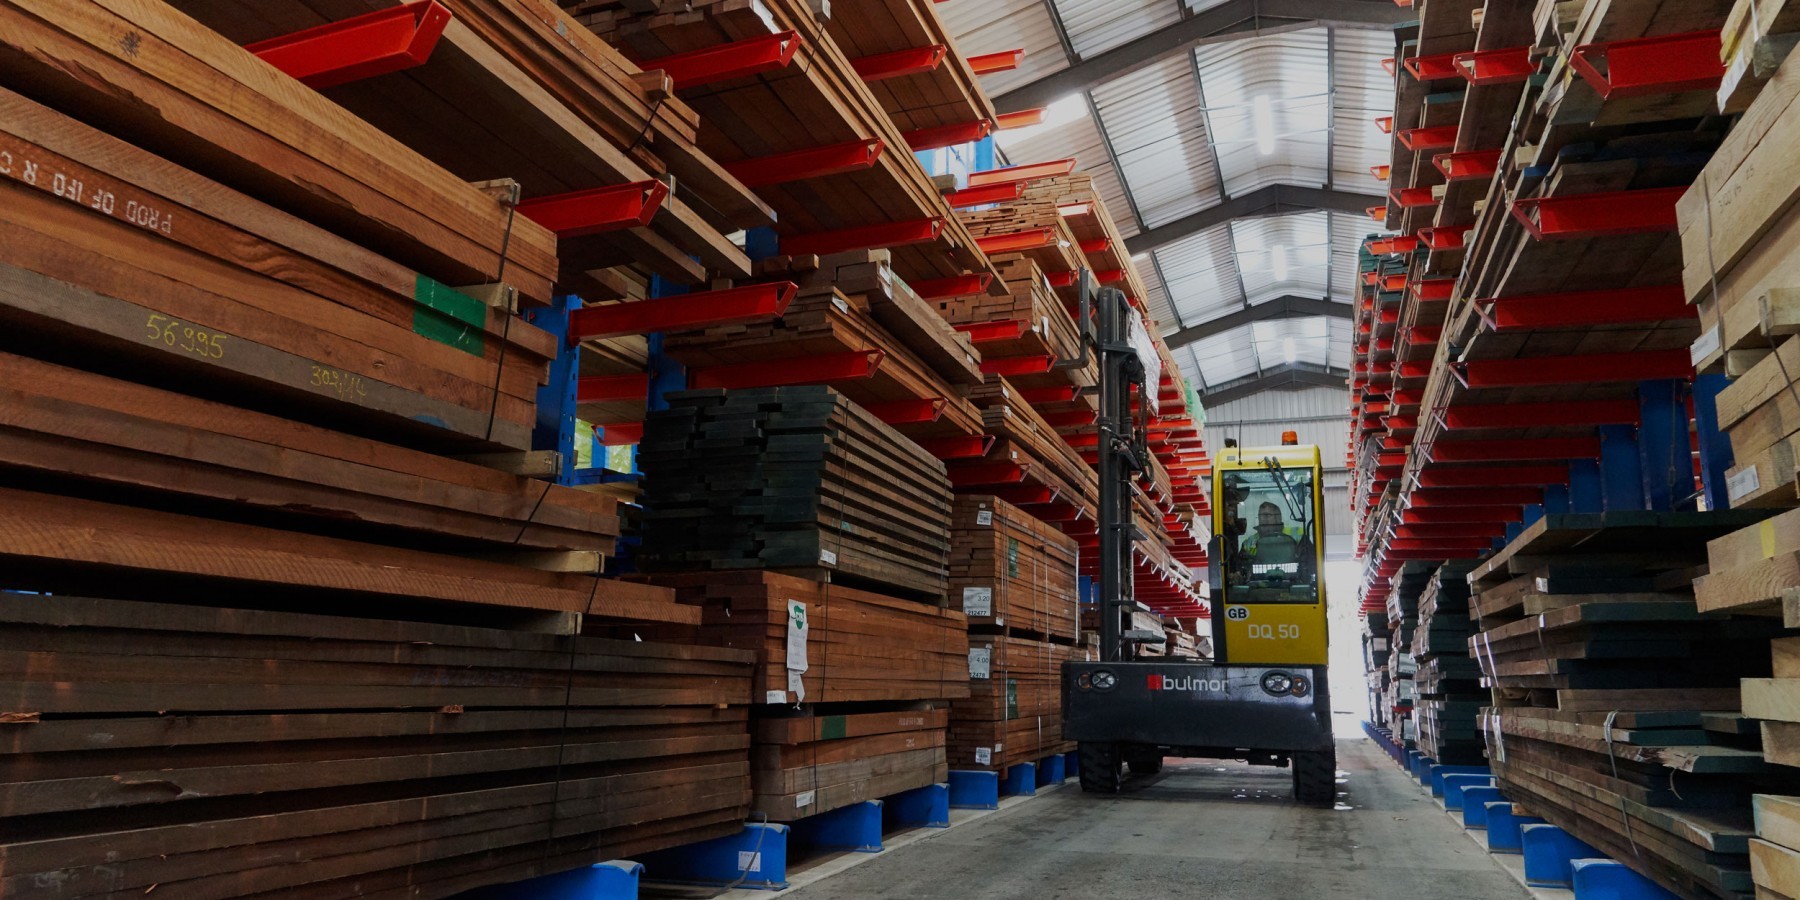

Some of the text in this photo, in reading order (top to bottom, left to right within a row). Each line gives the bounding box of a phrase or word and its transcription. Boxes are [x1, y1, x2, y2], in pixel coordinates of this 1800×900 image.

[23, 159, 39, 185] R
[53, 173, 83, 203] IFO
[91, 188, 115, 215] OF
[125, 200, 172, 234] PROD
[145, 314, 228, 360] 56995
[1228, 608, 1248, 619] GB
[1248, 624, 1300, 640] DQ 50
[1162, 674, 1230, 692] bulmor
